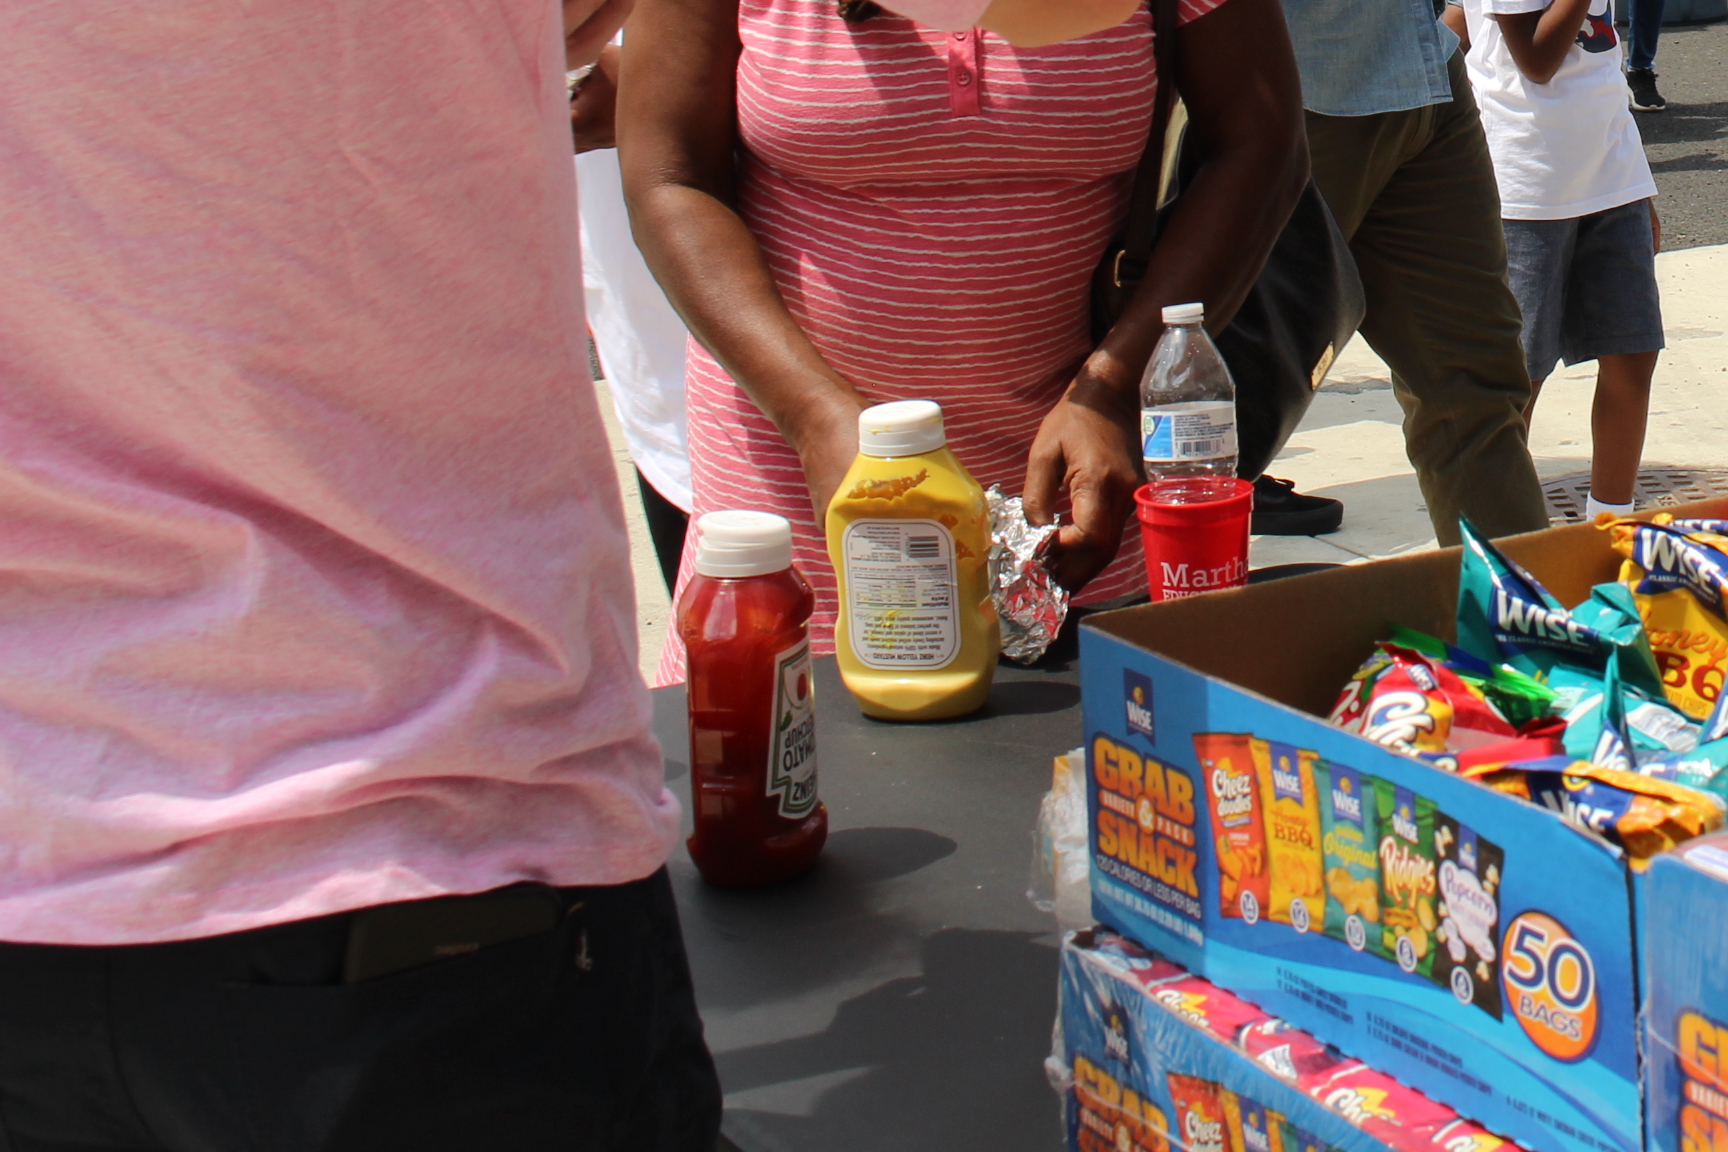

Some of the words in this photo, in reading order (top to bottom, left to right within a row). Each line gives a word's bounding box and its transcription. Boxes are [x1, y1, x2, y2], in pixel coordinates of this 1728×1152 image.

[1641, 527, 1721, 596] WISE
[1497, 588, 1590, 647] WISE
[1126, 699, 1154, 731] WISE
[1093, 736, 1197, 827] GRAB
[1211, 768, 1252, 799] Cheez
[1273, 769, 1301, 793] WISE
[1138, 798, 1155, 831] &
[1216, 795, 1253, 817] doodles
[1332, 788, 1362, 816] WISE
[1273, 822, 1315, 851] BBQ
[1391, 812, 1419, 845] WISE
[1097, 808, 1200, 899] SNACK
[1323, 831, 1379, 871] Original
[1379, 834, 1436, 912] Ridgies
[1444, 864, 1495, 917] Popcorn
[1503, 918, 1596, 1012] 50
[1519, 993, 1583, 1042] BAGS
[1073, 1054, 1171, 1152] GRAB
[1184, 1110, 1224, 1141] Cheez
